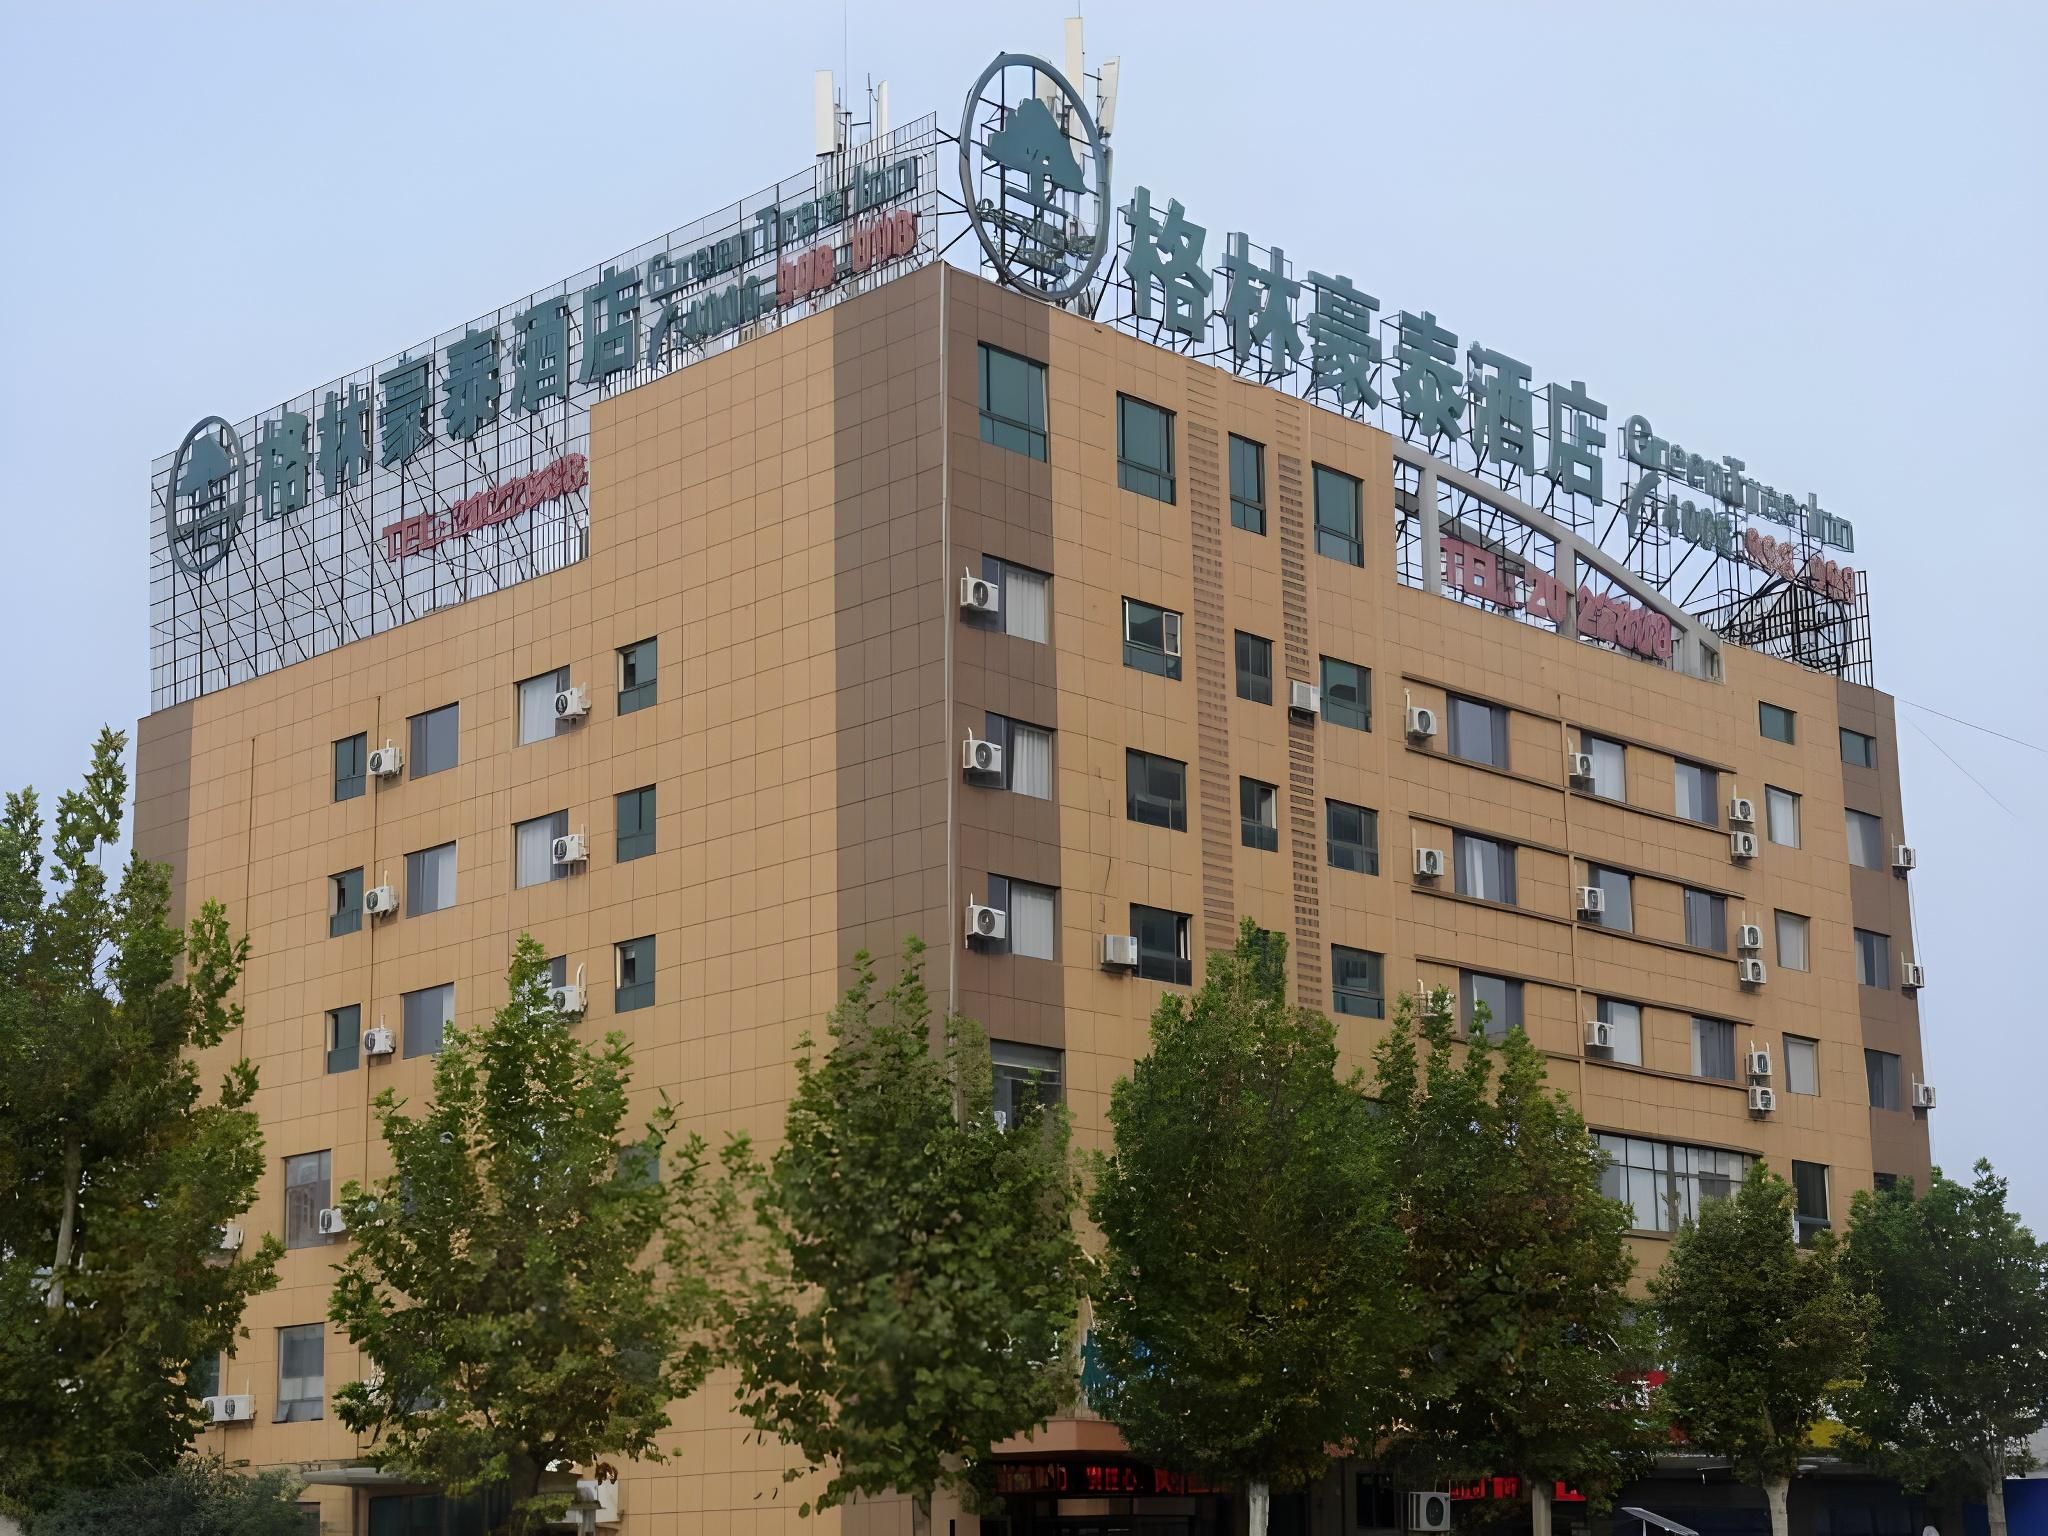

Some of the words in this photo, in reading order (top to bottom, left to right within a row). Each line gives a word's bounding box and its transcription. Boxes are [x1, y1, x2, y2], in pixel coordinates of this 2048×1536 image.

[1124, 185, 1608, 506] 格林豪泰酒店
